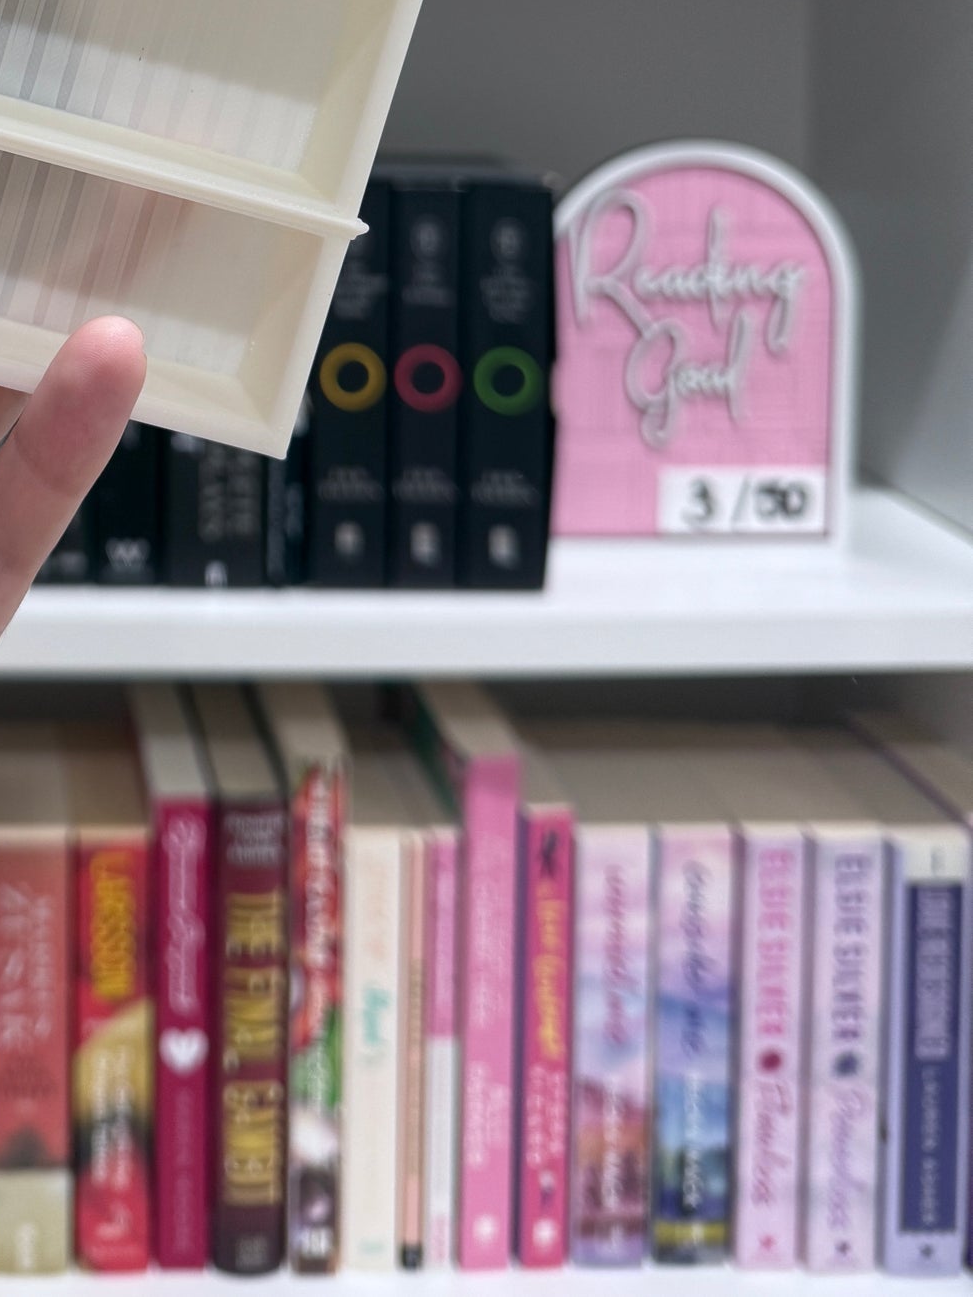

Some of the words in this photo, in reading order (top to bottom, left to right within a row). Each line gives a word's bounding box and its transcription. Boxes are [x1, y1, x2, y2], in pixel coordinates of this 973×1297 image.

[569, 186, 804, 359] Reading
[624, 306, 753, 455] Goal
[835, 852, 871, 935] ELSIE
[834, 942, 869, 1040] SILVER
